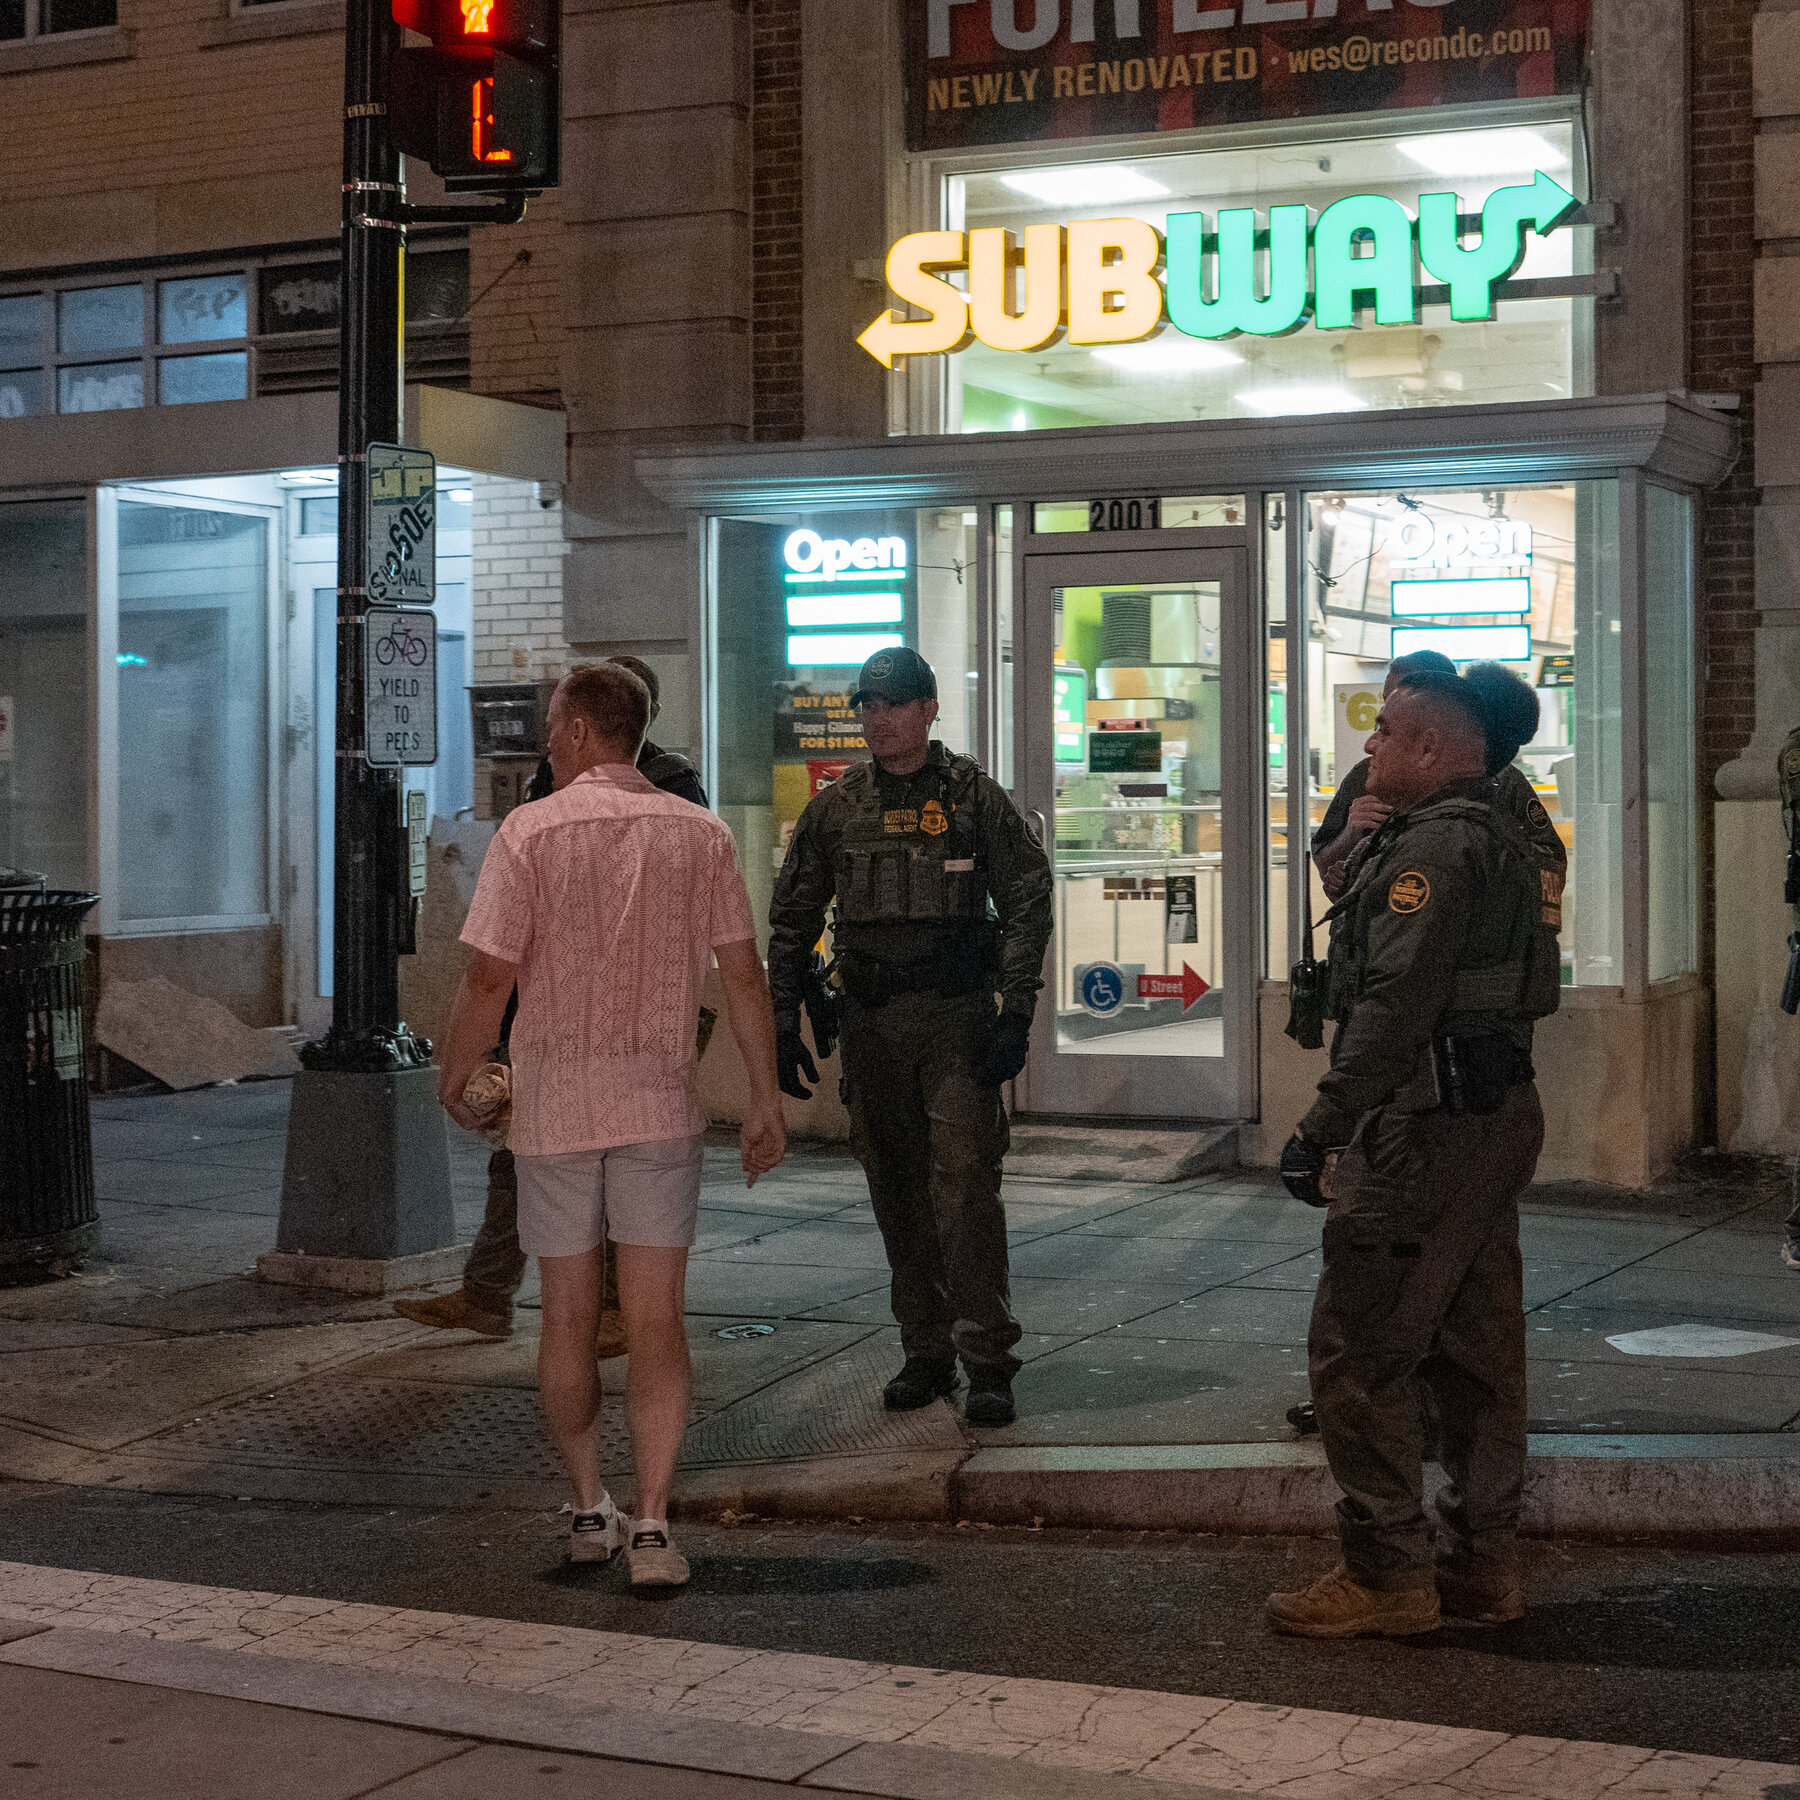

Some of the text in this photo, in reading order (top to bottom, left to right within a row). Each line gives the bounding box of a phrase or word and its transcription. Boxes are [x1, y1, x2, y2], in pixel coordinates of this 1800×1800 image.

[927, 68, 1040, 111] NEWLY
[1053, 46, 1258, 99] RENOVATED
[1287, 26, 1552, 74] wes@recondc.com
[857, 169, 1576, 370] SUBWAY
[1091, 500, 1160, 531] 2001
[1390, 511, 1533, 567] Open
[784, 529, 906, 581] Open
[1409, 633, 1510, 657] Caterng
[379, 678, 420, 698] YIELD
[393, 705, 410, 724] TO
[800, 737, 826, 749] FOR
[1150, 979, 1184, 994] Street
